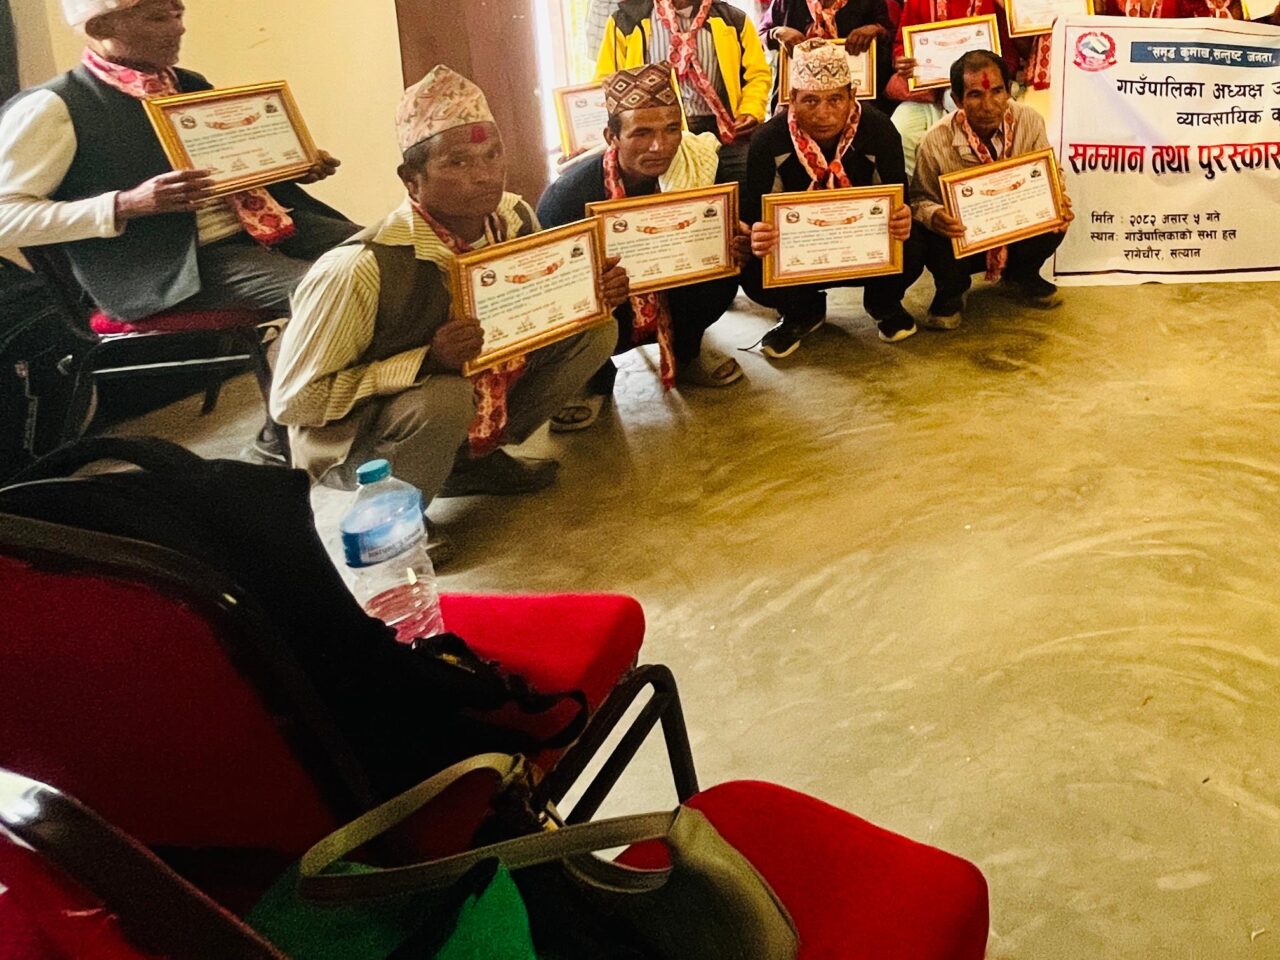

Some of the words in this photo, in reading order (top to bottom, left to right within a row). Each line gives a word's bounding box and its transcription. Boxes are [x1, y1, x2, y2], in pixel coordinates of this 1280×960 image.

[1116, 73, 1206, 99] गाउँपालिका
[1212, 82, 1265, 100] अध्यक्ष
[1176, 105, 1264, 127] व्यावसायिक
[1068, 143, 1146, 175] सम्मान
[1151, 144, 1191, 175] तथा
[1091, 210, 1115, 224] मिति
[1130, 214, 1157, 227] २०८२
[1162, 213, 1189, 225] असार
[1206, 210, 1221, 222] गते
[1124, 227, 1193, 242] गाउँपालिकाको
[1197, 229, 1218, 241] सभा
[1221, 228, 1237, 241] हल
